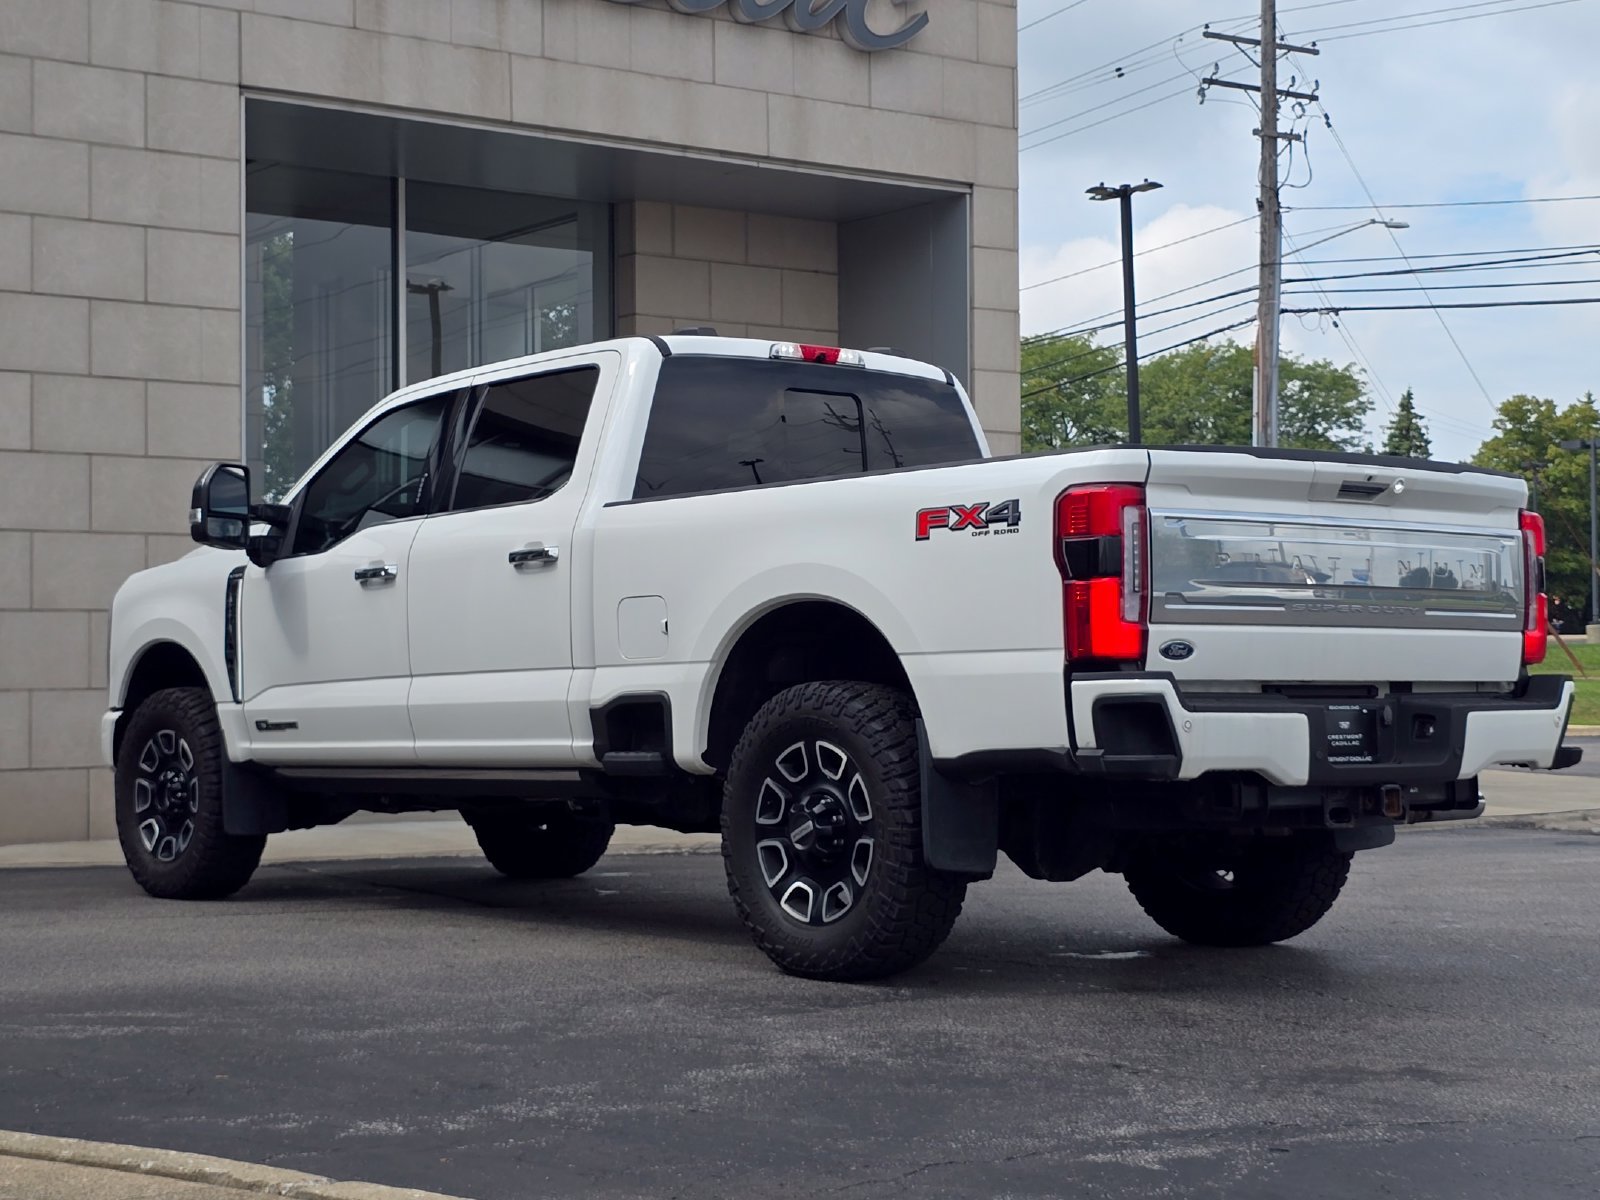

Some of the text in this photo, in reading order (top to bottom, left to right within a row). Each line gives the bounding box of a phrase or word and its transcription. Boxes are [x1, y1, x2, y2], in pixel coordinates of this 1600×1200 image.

[915, 499, 1021, 541] FX4
[993, 528, 1019, 536] ROAD
[1292, 603, 1420, 616] SUPER DUTY
